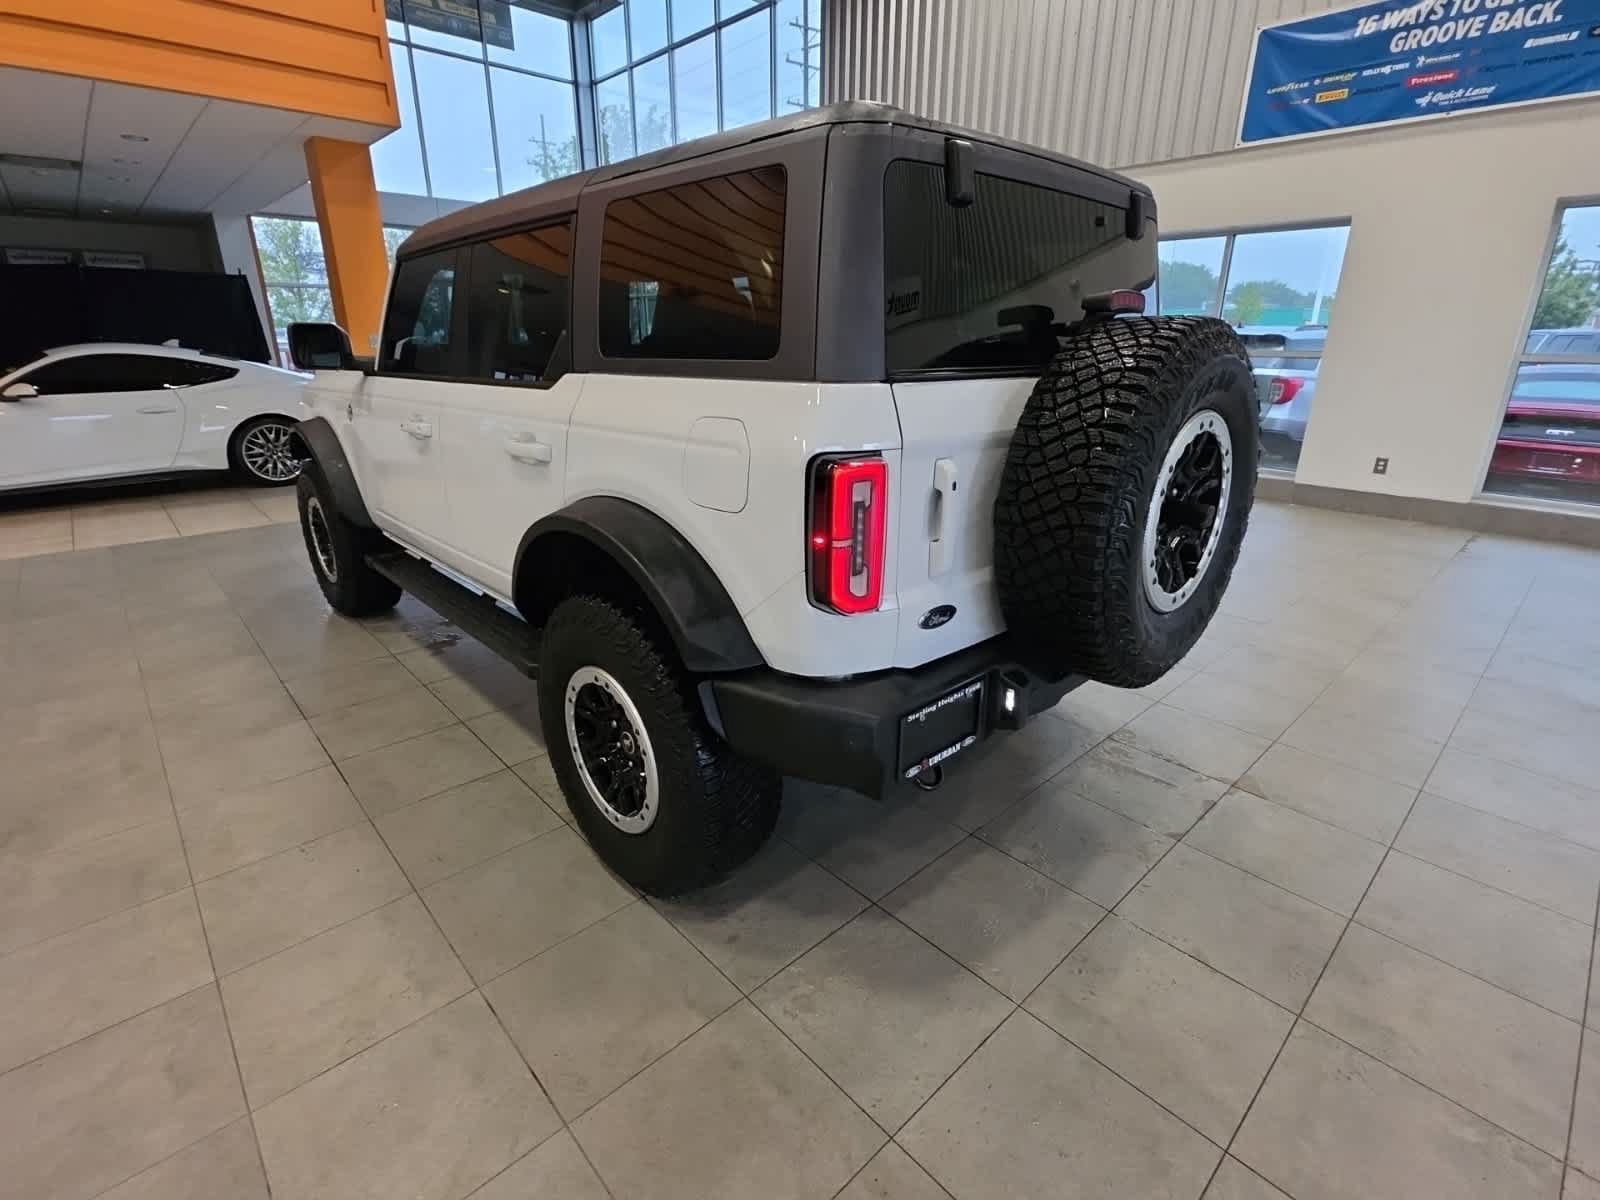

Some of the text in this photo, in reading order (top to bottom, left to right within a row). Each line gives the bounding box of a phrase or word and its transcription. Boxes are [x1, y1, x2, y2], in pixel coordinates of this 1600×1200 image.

[1353, 14, 1380, 38] 16
[1381, 0, 1445, 31] WAYS
[1387, 14, 1489, 53] GROOVE
[1487, 0, 1564, 34] BACK.
[1431, 88, 1466, 104] Quick
[1464, 85, 1497, 97] Lane
[907, 704, 937, 723] Sterling
